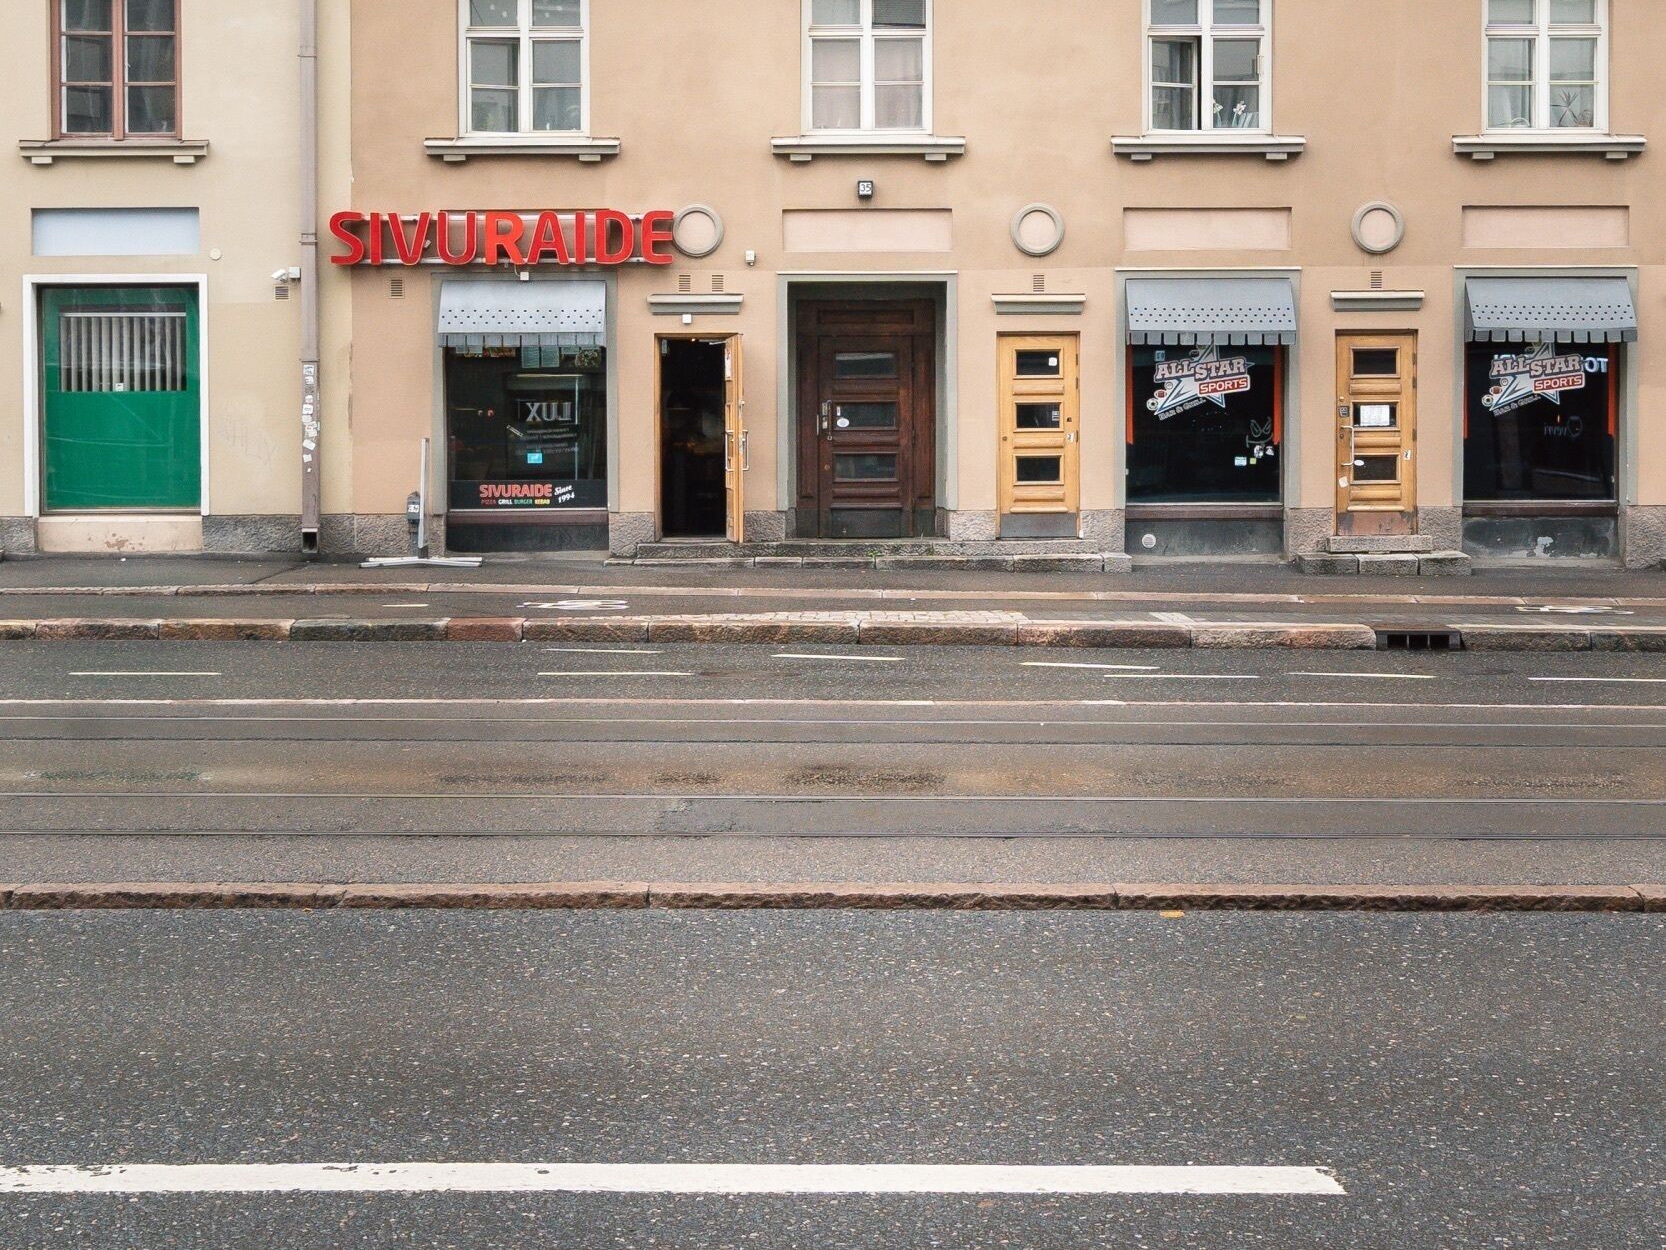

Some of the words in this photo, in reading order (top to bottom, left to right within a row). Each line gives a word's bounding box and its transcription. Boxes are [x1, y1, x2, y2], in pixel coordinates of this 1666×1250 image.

[860, 183, 872, 193] 35
[328, 210, 674, 265] SIVURAIDE
[1199, 378, 1248, 393] SPORTS
[1535, 375, 1582, 390] SPORTS
[480, 484, 552, 497] SIVURAIDE
[554, 485, 572, 495] Since
[558, 492, 575, 503] 1994
